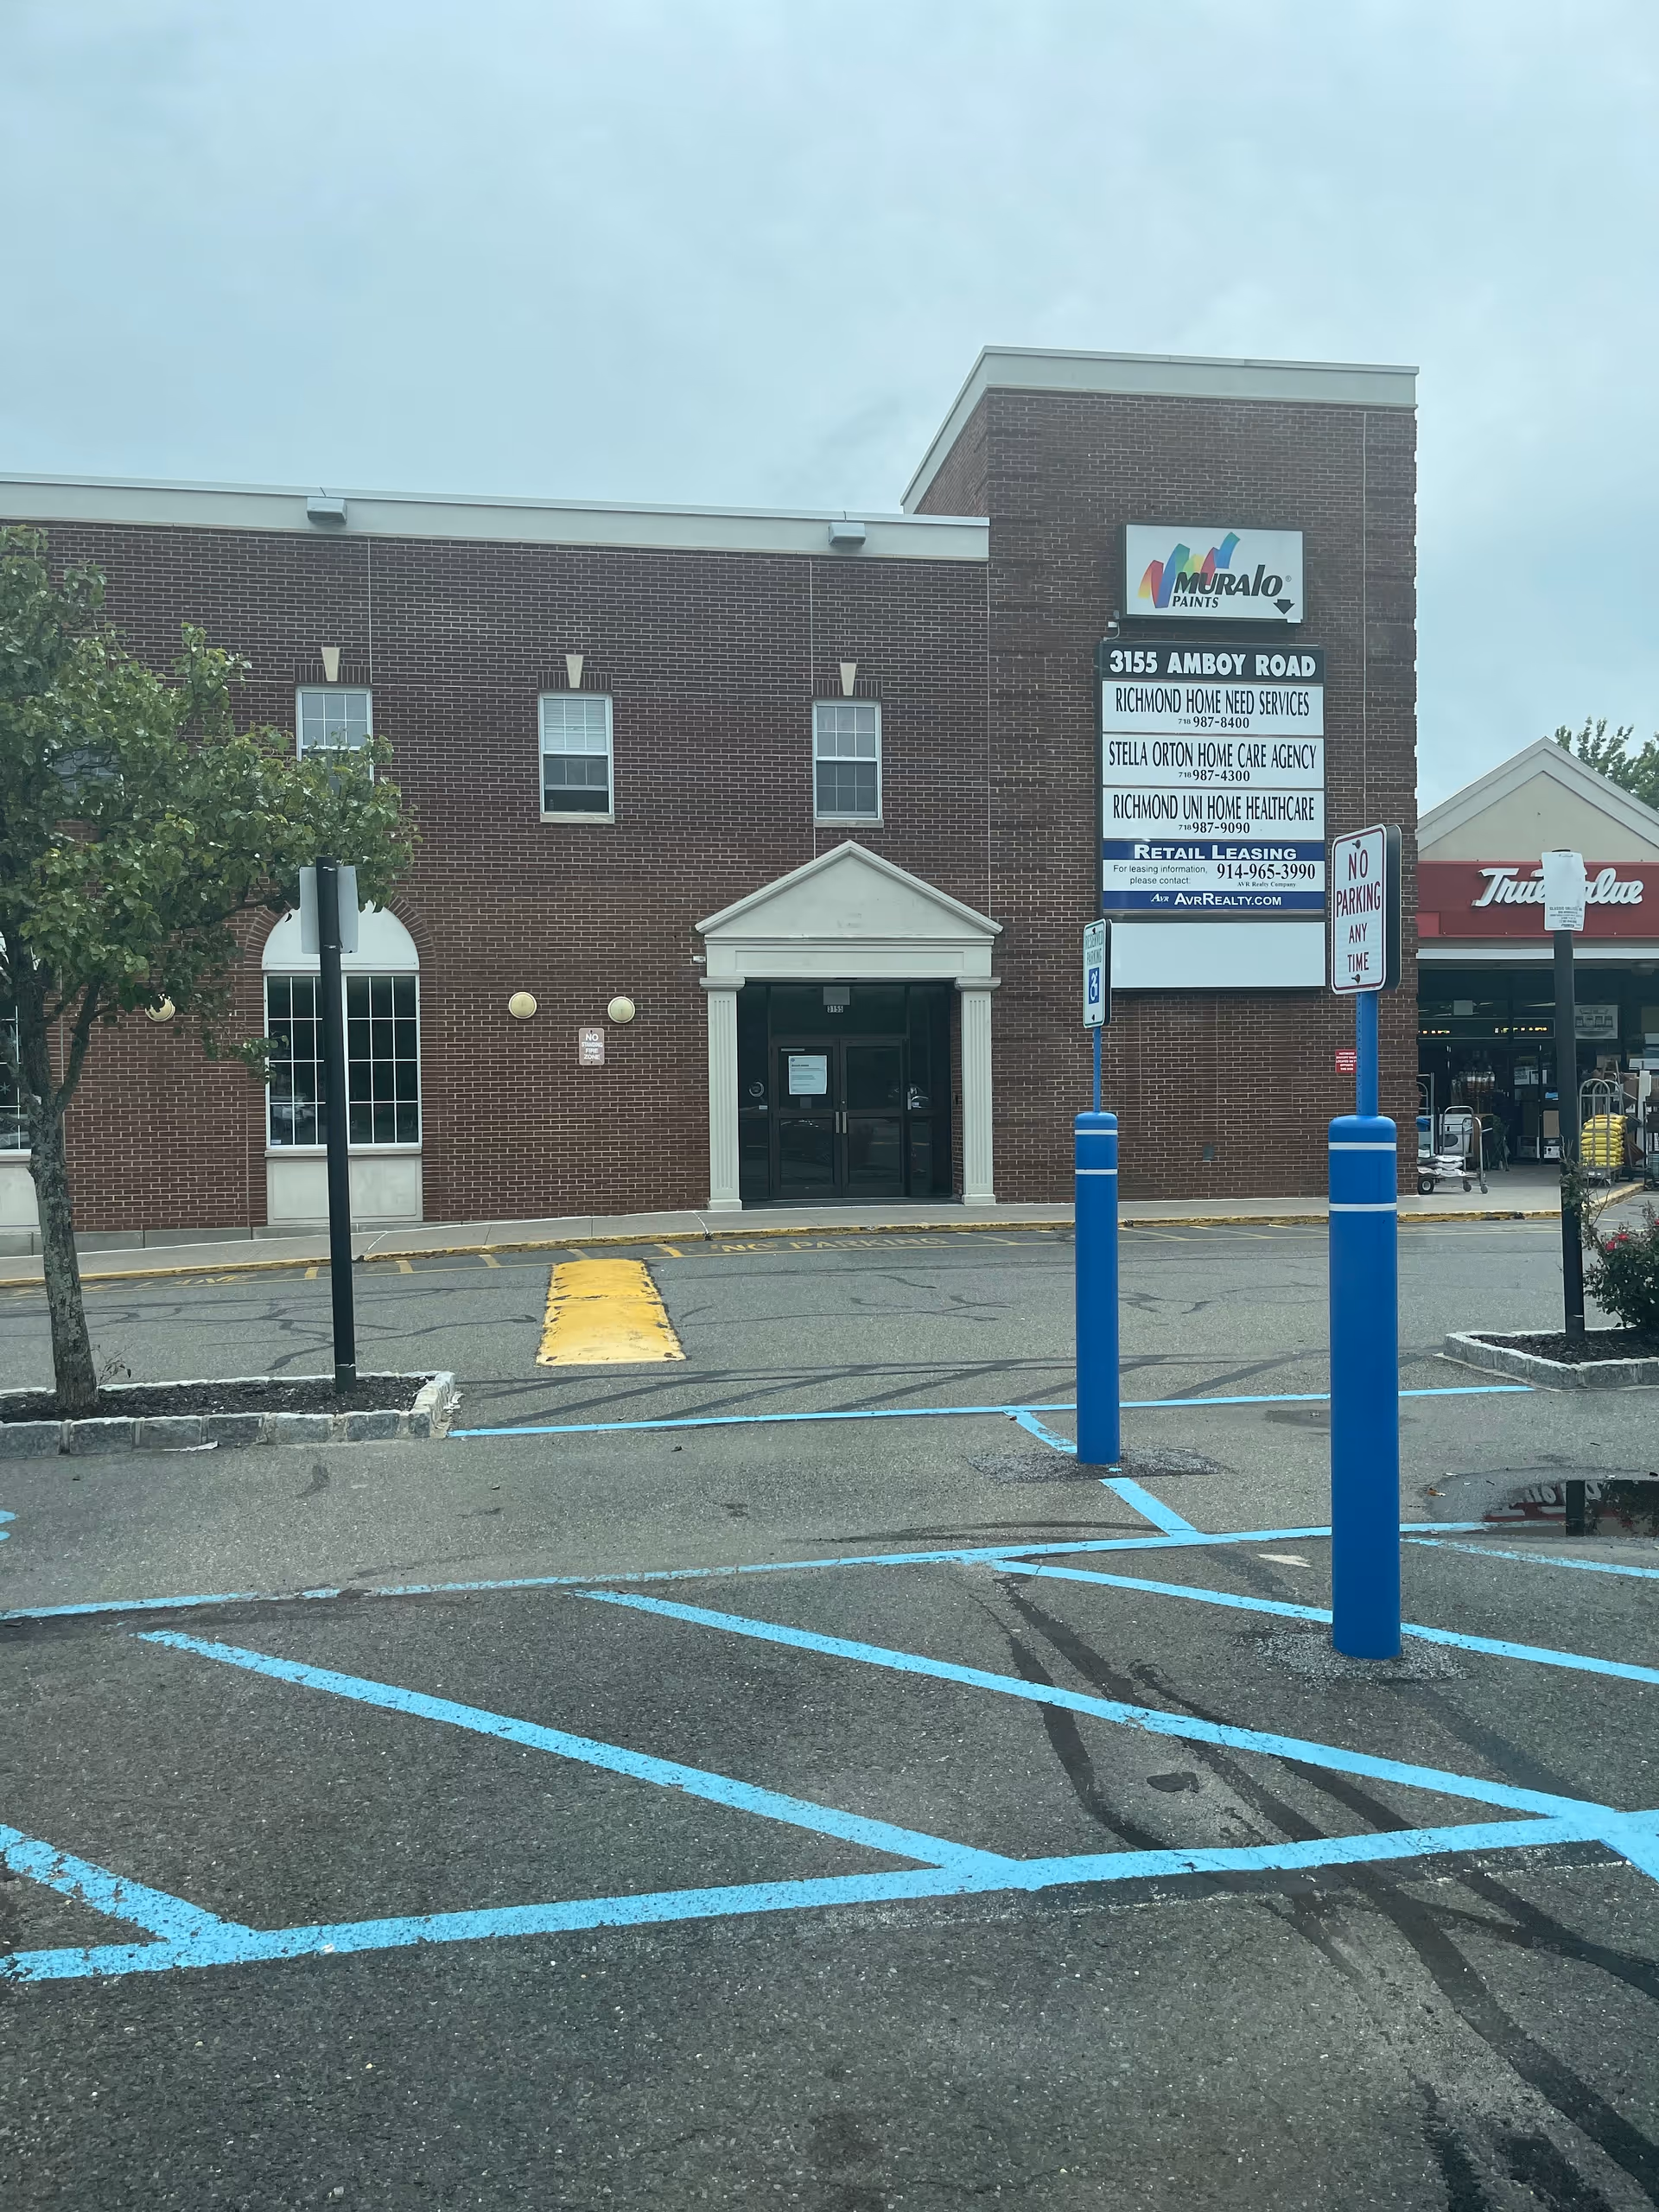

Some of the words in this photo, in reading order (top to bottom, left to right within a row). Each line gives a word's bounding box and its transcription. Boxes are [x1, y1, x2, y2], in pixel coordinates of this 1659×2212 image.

[1173, 596, 1219, 608] PAINTS
[1109, 650, 1158, 674] 3155
[1167, 652, 1246, 677] AMBOY
[1255, 654, 1316, 677] ROAD
[1116, 687, 1181, 714] RICHMOND
[1186, 689, 1221, 715] HOME
[1225, 690, 1255, 715] NEED
[1259, 691, 1309, 716] SERVICES
[1192, 716, 1249, 729] 987-8400
[1109, 741, 1147, 766] STELLA
[1152, 741, 1193, 767] ORTON
[1198, 742, 1233, 768] HOME
[1237, 743, 1267, 768] CARE
[1271, 744, 1316, 769] AGENCY
[1192, 770, 1250, 783] 987-4300
[1113, 794, 1178, 820] RICHMOND
[1183, 795, 1203, 820] UNI
[1207, 796, 1241, 820] HOME
[1246, 796, 1314, 821] HEALTHCARE
[1192, 822, 1250, 835] 987-9090
[1134, 844, 1205, 860] RETAIL
[1211, 845, 1297, 860] LEASING
[1113, 865, 1127, 874] For
[1129, 865, 1158, 876] leasing
[1160, 865, 1208, 875] information,
[1217, 863, 1316, 880] 914-965-3990
[1348, 849, 1368, 880] NO
[1129, 876, 1156, 887] please
[1159, 876, 1191, 885] contact:
[1336, 881, 1381, 918] PARKING
[1349, 923, 1368, 944] ANY
[1086, 948, 1102, 965] PARKING
[1347, 952, 1370, 973] TIME
[790, 1238, 948, 1250] PARKING
